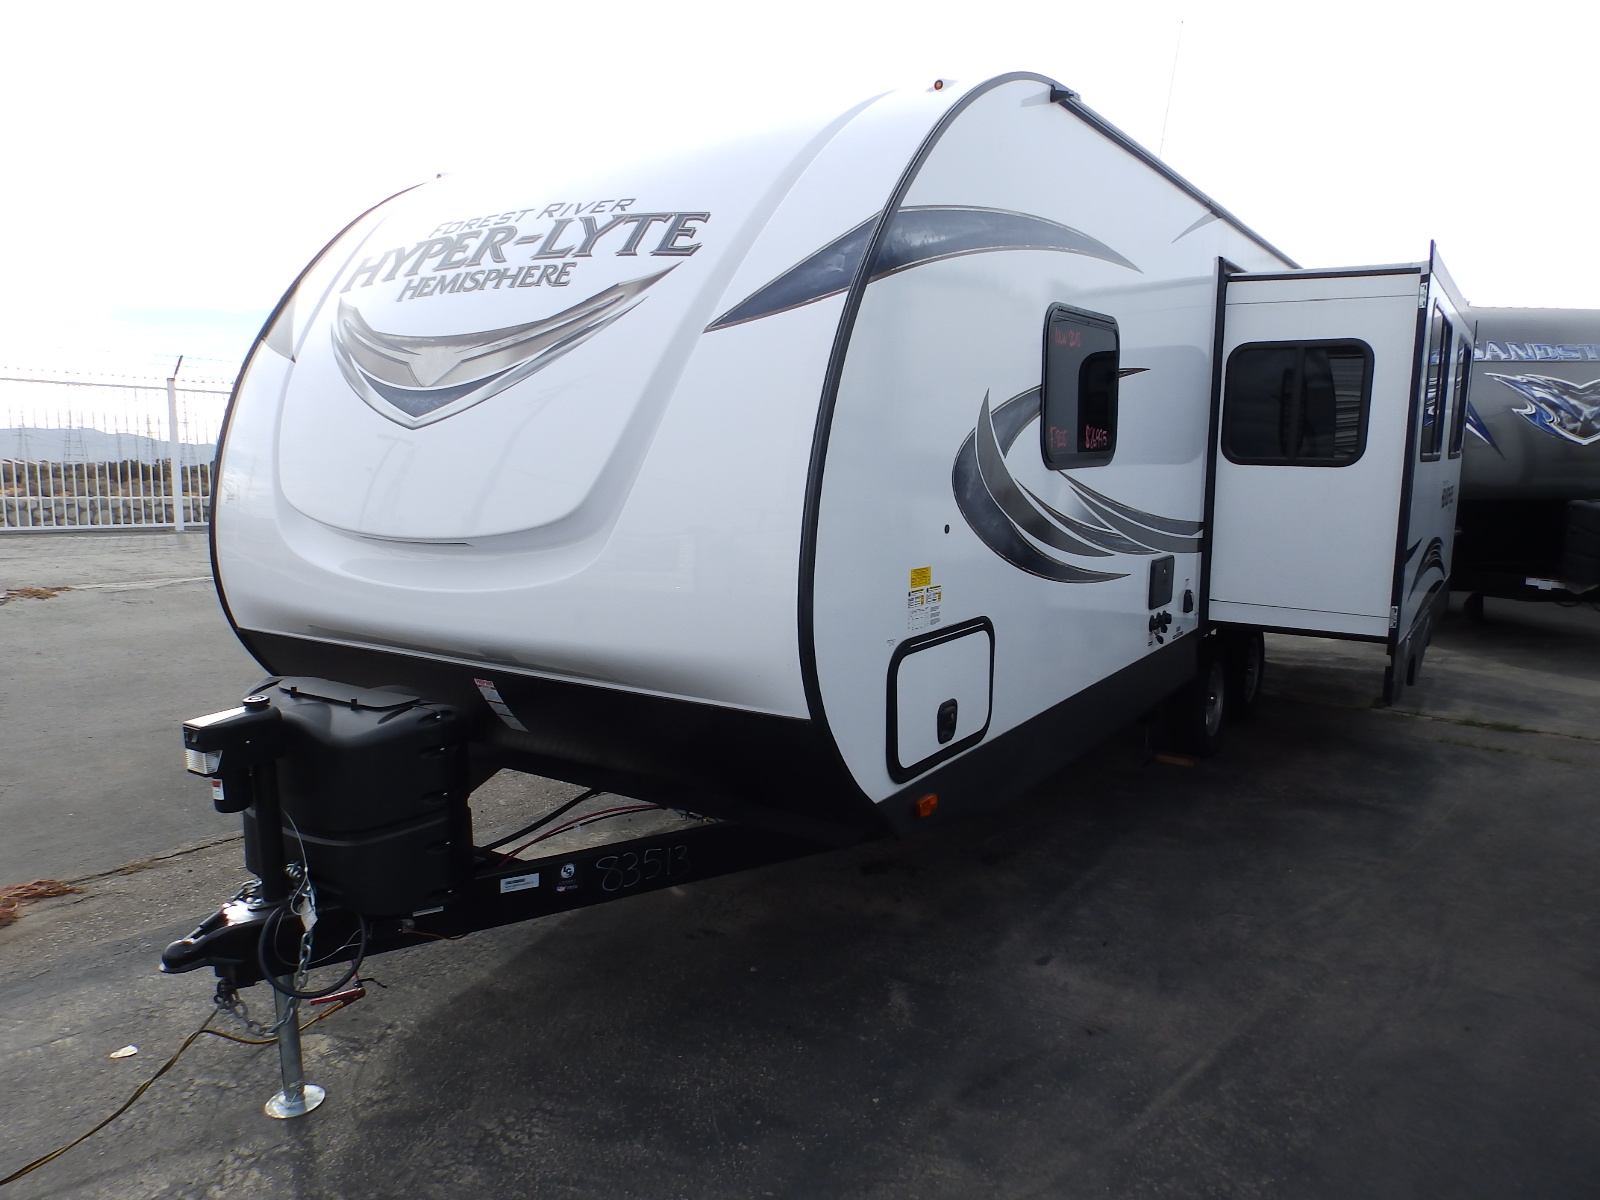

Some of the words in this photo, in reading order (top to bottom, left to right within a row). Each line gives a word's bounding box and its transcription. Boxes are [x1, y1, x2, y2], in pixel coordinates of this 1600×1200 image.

[428, 209, 535, 238] FOREST
[538, 198, 636, 220] RIVER
[339, 211, 711, 294] HYPER-LYTE
[396, 261, 576, 302] HEMISPHERE
[595, 845, 691, 891] 83513
